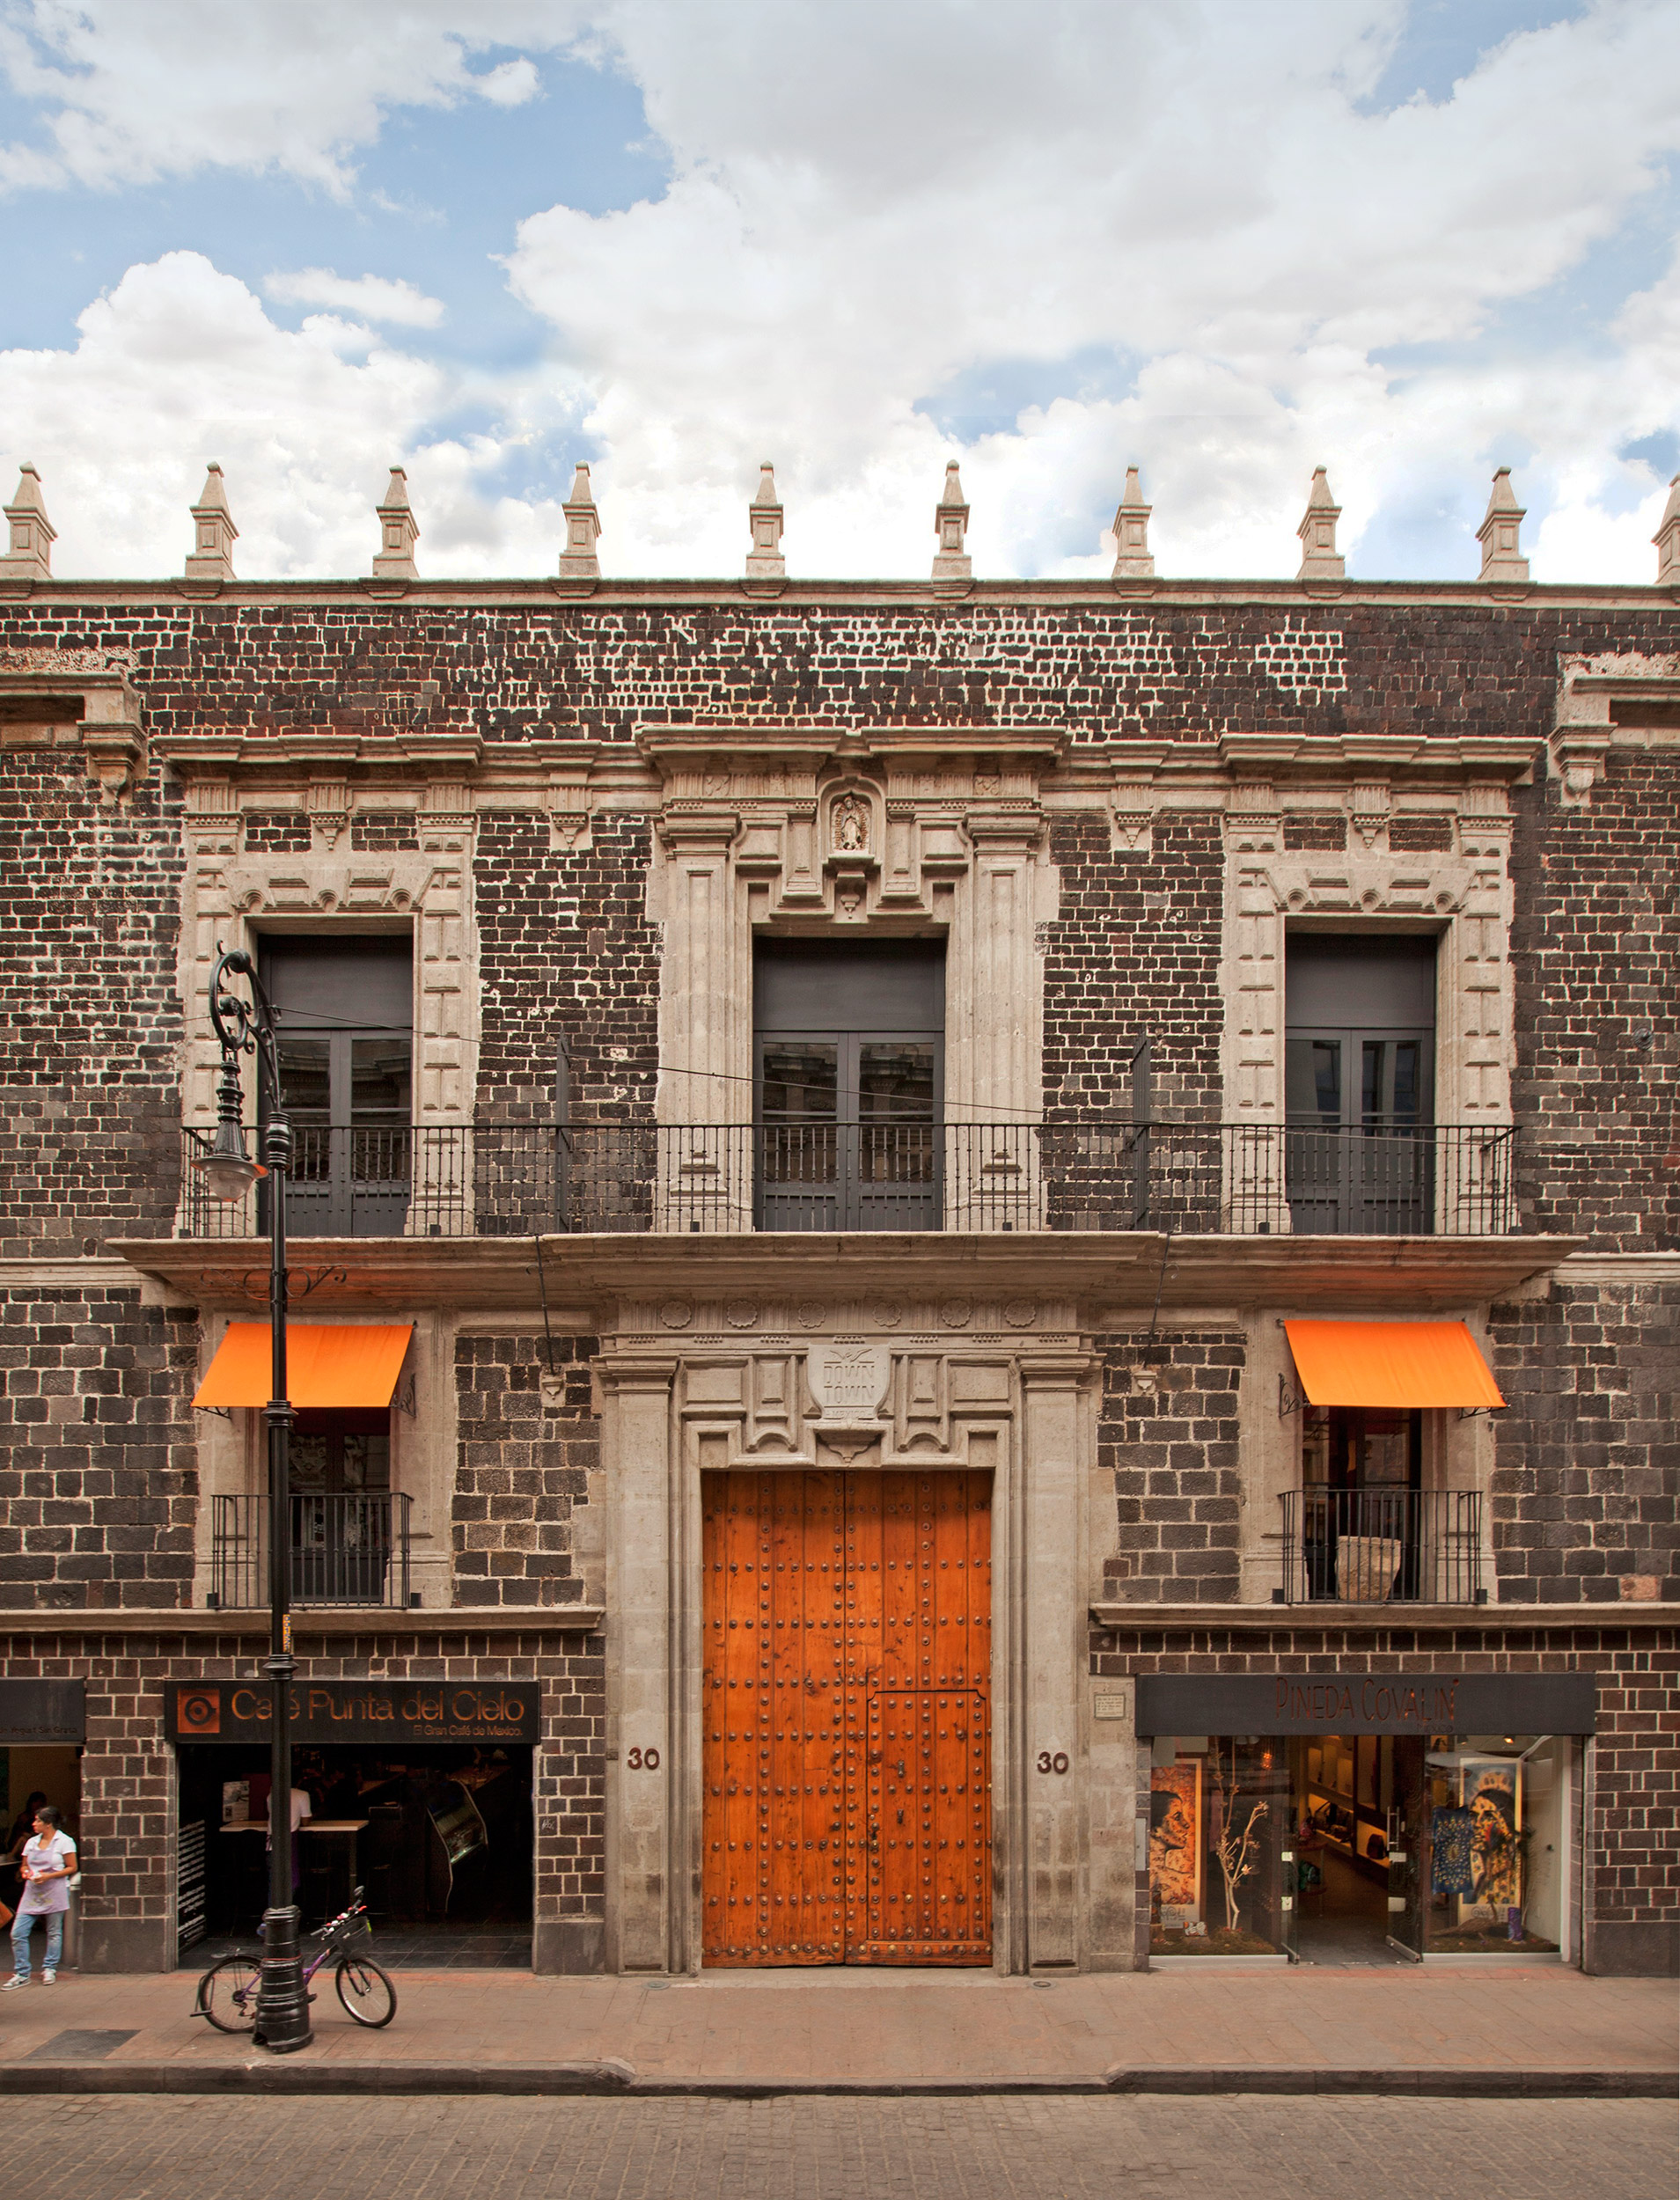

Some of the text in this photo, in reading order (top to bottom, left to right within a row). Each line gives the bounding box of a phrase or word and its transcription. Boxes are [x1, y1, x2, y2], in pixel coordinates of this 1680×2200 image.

[823, 1365, 875, 1383] DOWN
[823, 1385, 875, 1404] TOWN
[231, 1689, 525, 1721] Caé Punta del Cielo
[1276, 1676, 1455, 1720] PINEDA COVALIN
[424, 1724, 447, 1735] Gran
[449, 1724, 472, 1735] Café
[473, 1726, 485, 1735] de
[627, 1747, 660, 1771] 30
[1037, 1751, 1069, 1775] 30
